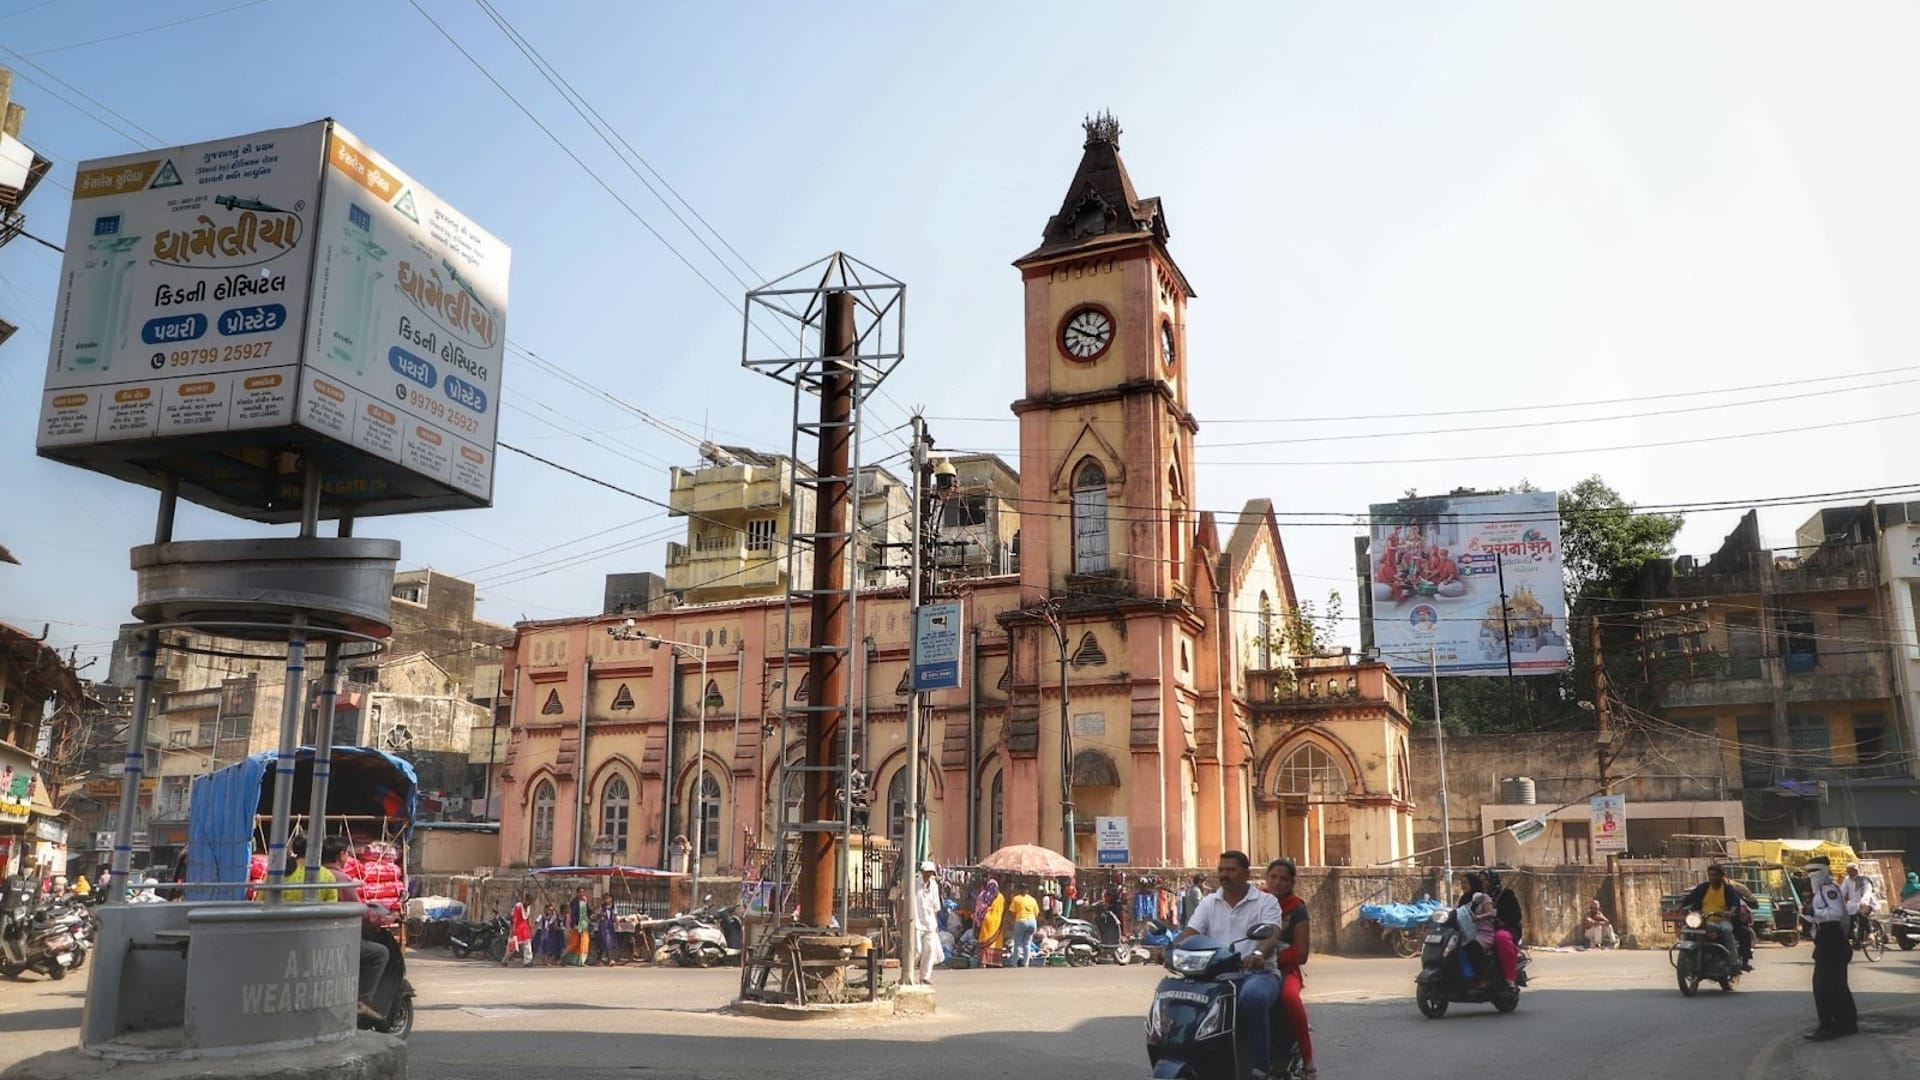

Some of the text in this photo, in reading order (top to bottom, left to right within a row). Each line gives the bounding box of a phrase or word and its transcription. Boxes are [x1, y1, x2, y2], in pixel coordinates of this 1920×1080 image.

[154, 274, 286, 307] કિડની હોસ્પિટલ
[154, 308, 277, 340] પથરી પ્રોસ્ટેટ
[170, 341, 273, 367] 99799 25927
[398, 315, 488, 382] કિડની હોસ્પિટલ
[398, 354, 482, 411] પથરી પ્રોસ્ટેટ
[410, 390, 445, 418] 99799
[446, 408, 480, 433] 25927
[241, 983, 308, 1014] WEAR
